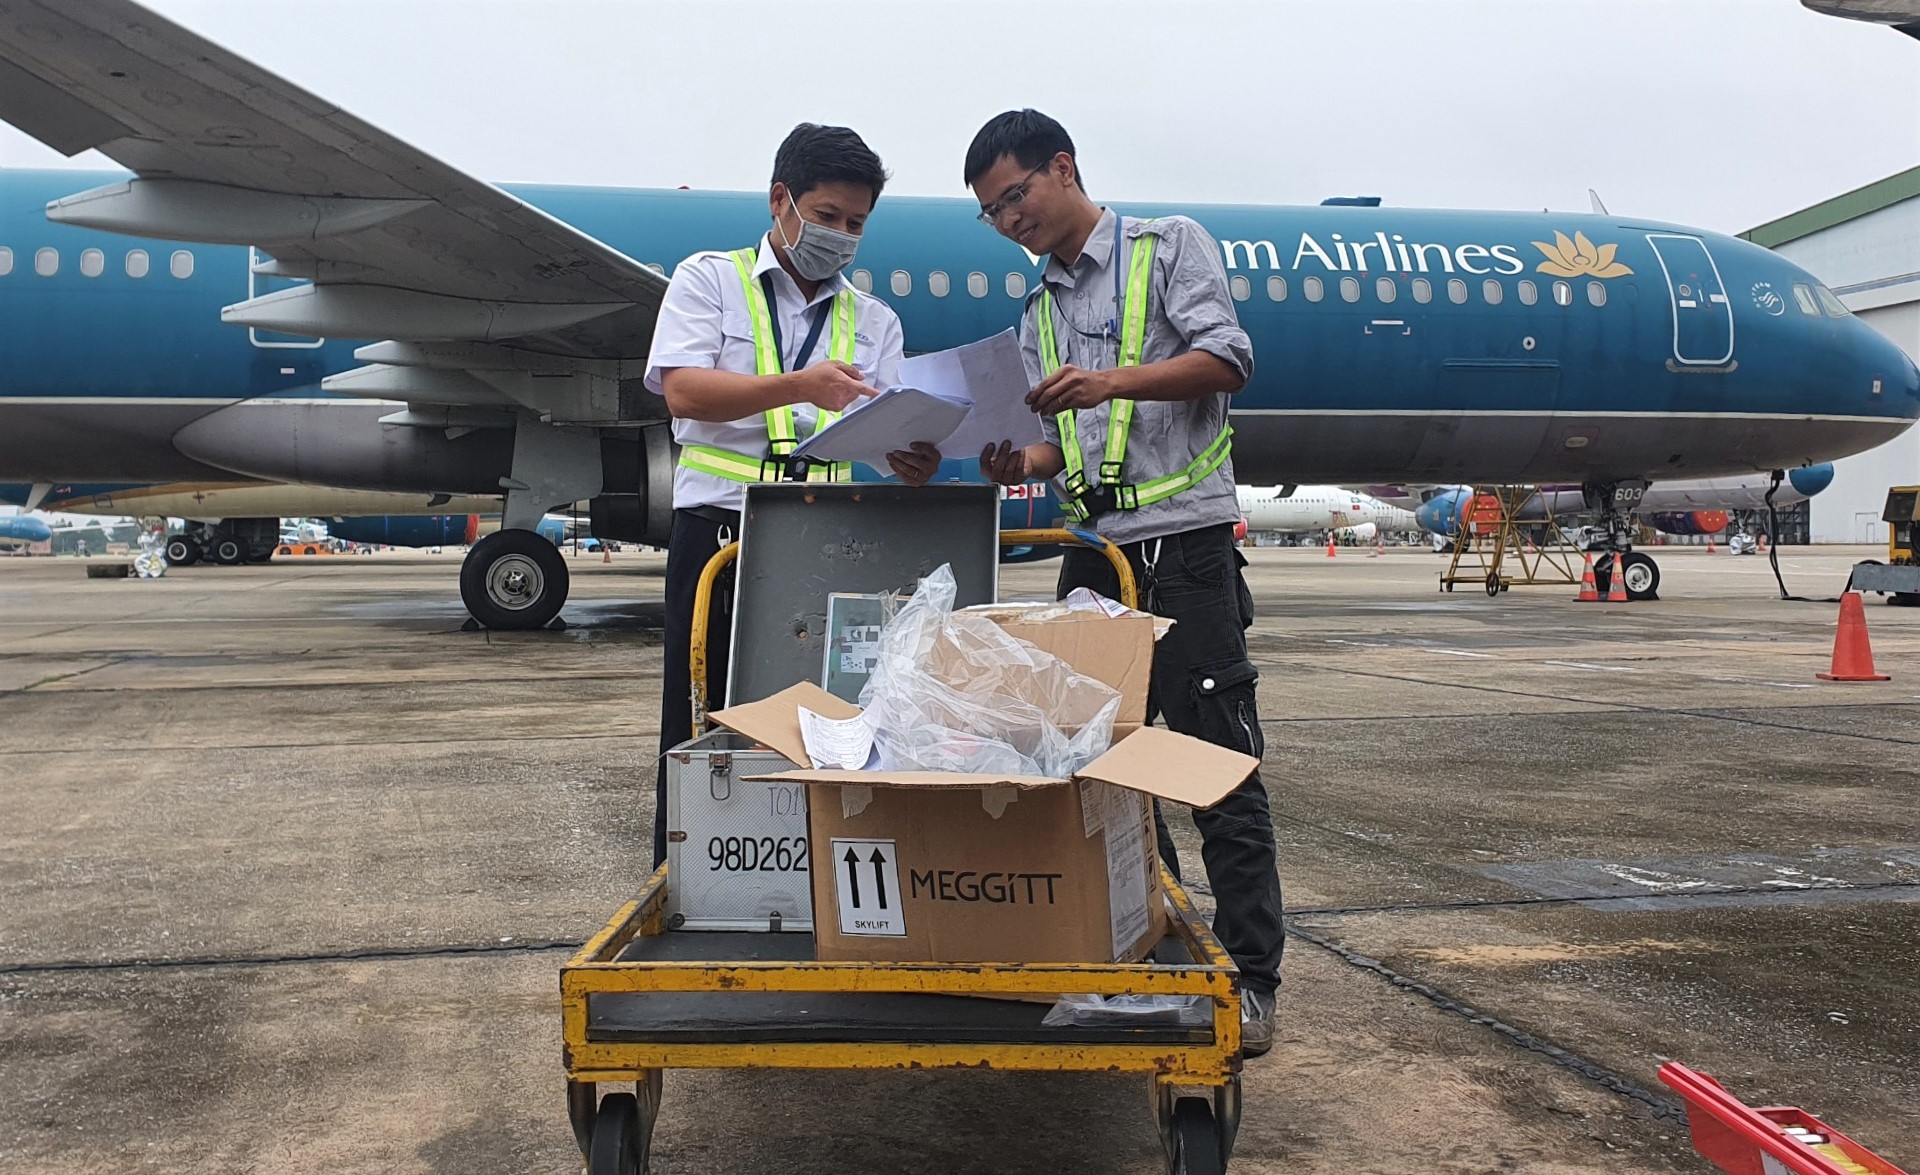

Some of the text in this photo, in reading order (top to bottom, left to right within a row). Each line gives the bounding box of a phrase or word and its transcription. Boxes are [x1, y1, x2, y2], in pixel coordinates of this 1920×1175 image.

[1292, 231, 1524, 275] Airlines
[1615, 487, 1642, 501] 603
[708, 836, 808, 871] 98D262
[855, 920, 889, 930] SKYLIFT
